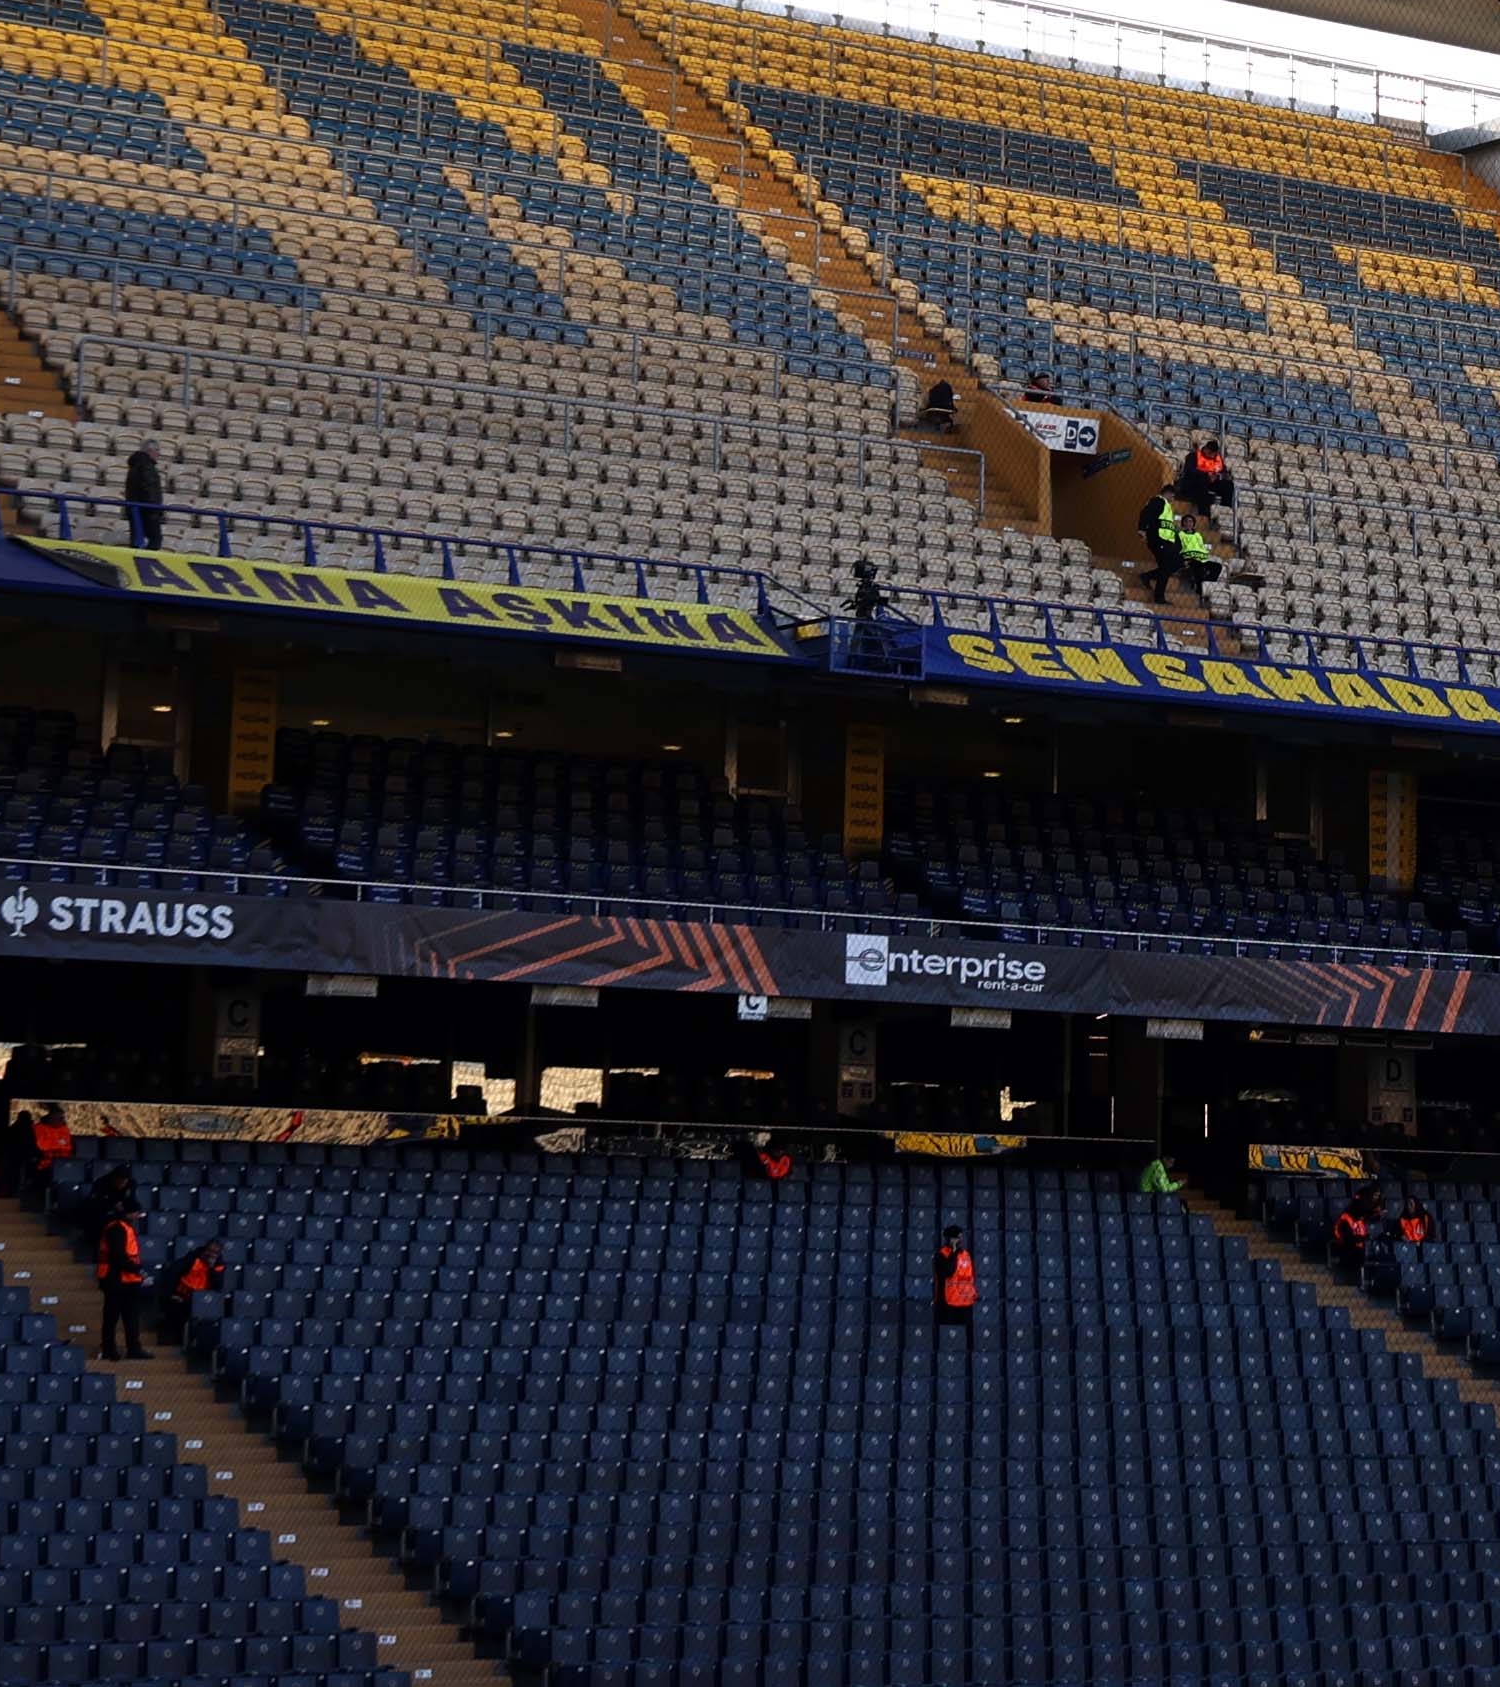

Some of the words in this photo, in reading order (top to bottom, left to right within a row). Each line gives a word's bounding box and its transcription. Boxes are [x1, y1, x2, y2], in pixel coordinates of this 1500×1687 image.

[131, 556, 411, 613] ARMA
[436, 586, 768, 648] AŞKINA
[946, 633, 1142, 688] SEN
[49, 895, 235, 940] STRAUSS
[857, 947, 1047, 985] enterprise
[976, 979, 1045, 993] rent-a-car
[850, 1030, 867, 1055] C
[1386, 1058, 1402, 1081] D
